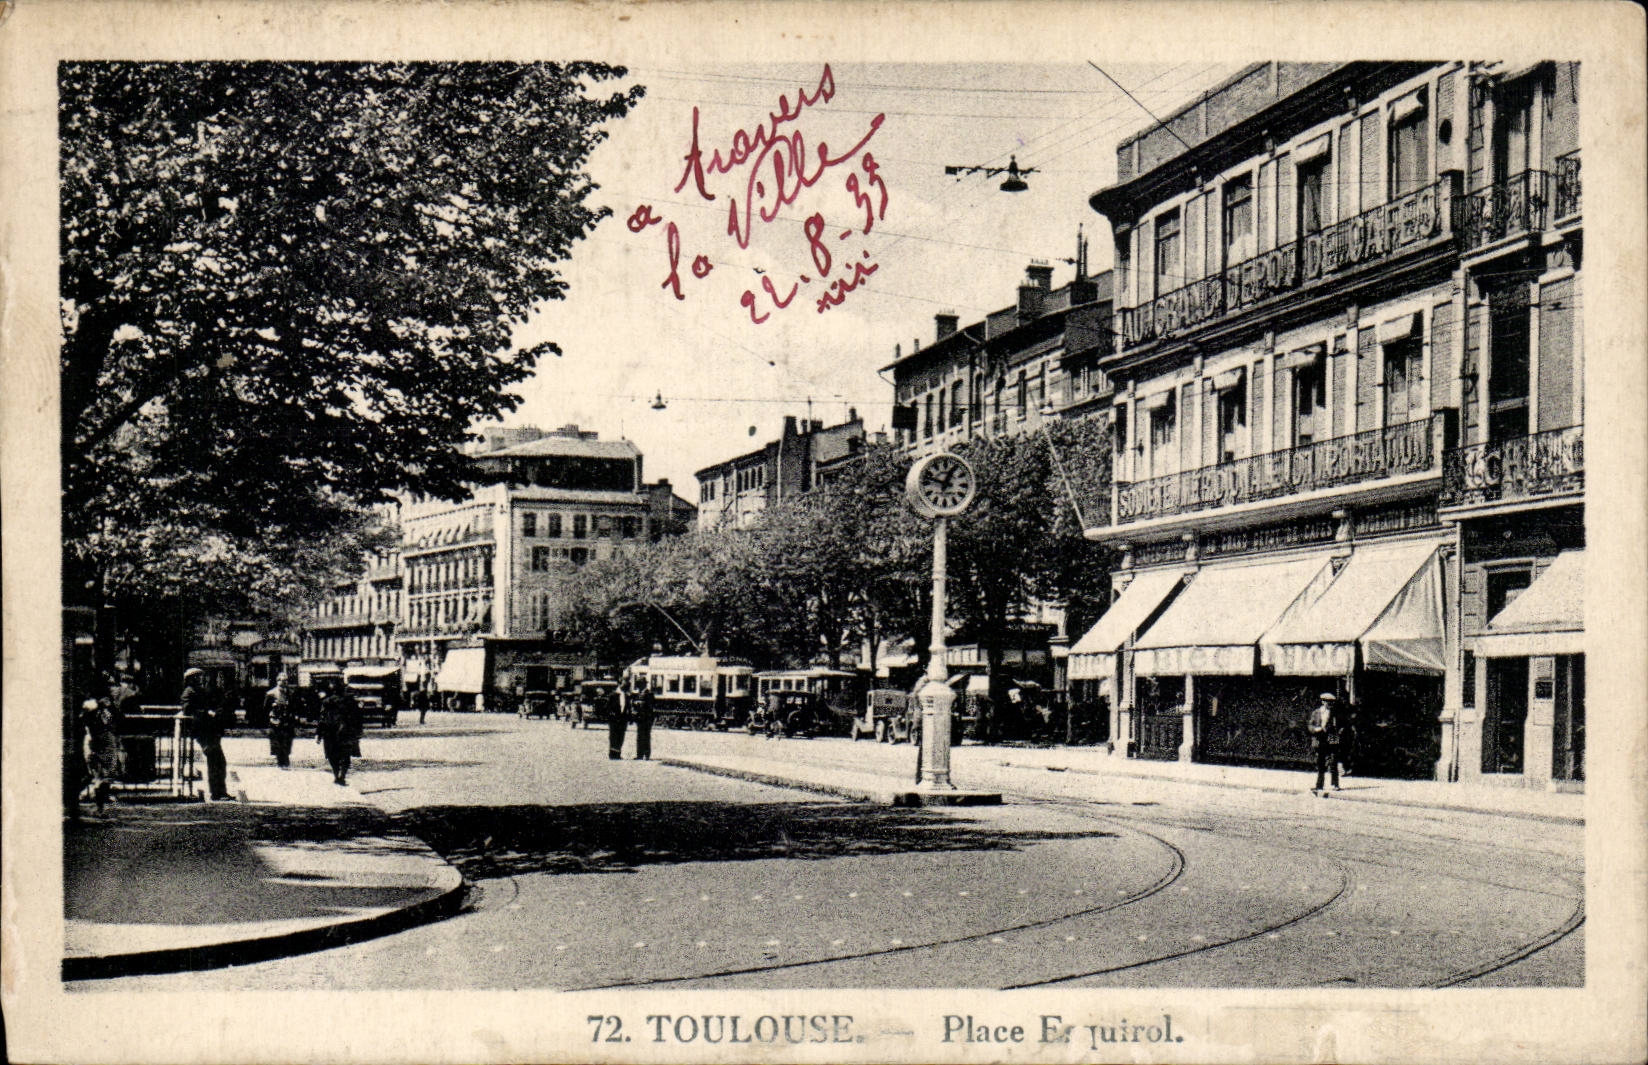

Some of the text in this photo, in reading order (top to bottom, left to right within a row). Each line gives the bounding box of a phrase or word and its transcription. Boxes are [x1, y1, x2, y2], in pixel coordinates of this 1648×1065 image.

[675, 63, 836, 201] travers
[728, 113, 886, 250] Ville
[1303, 231, 1341, 280] DE
